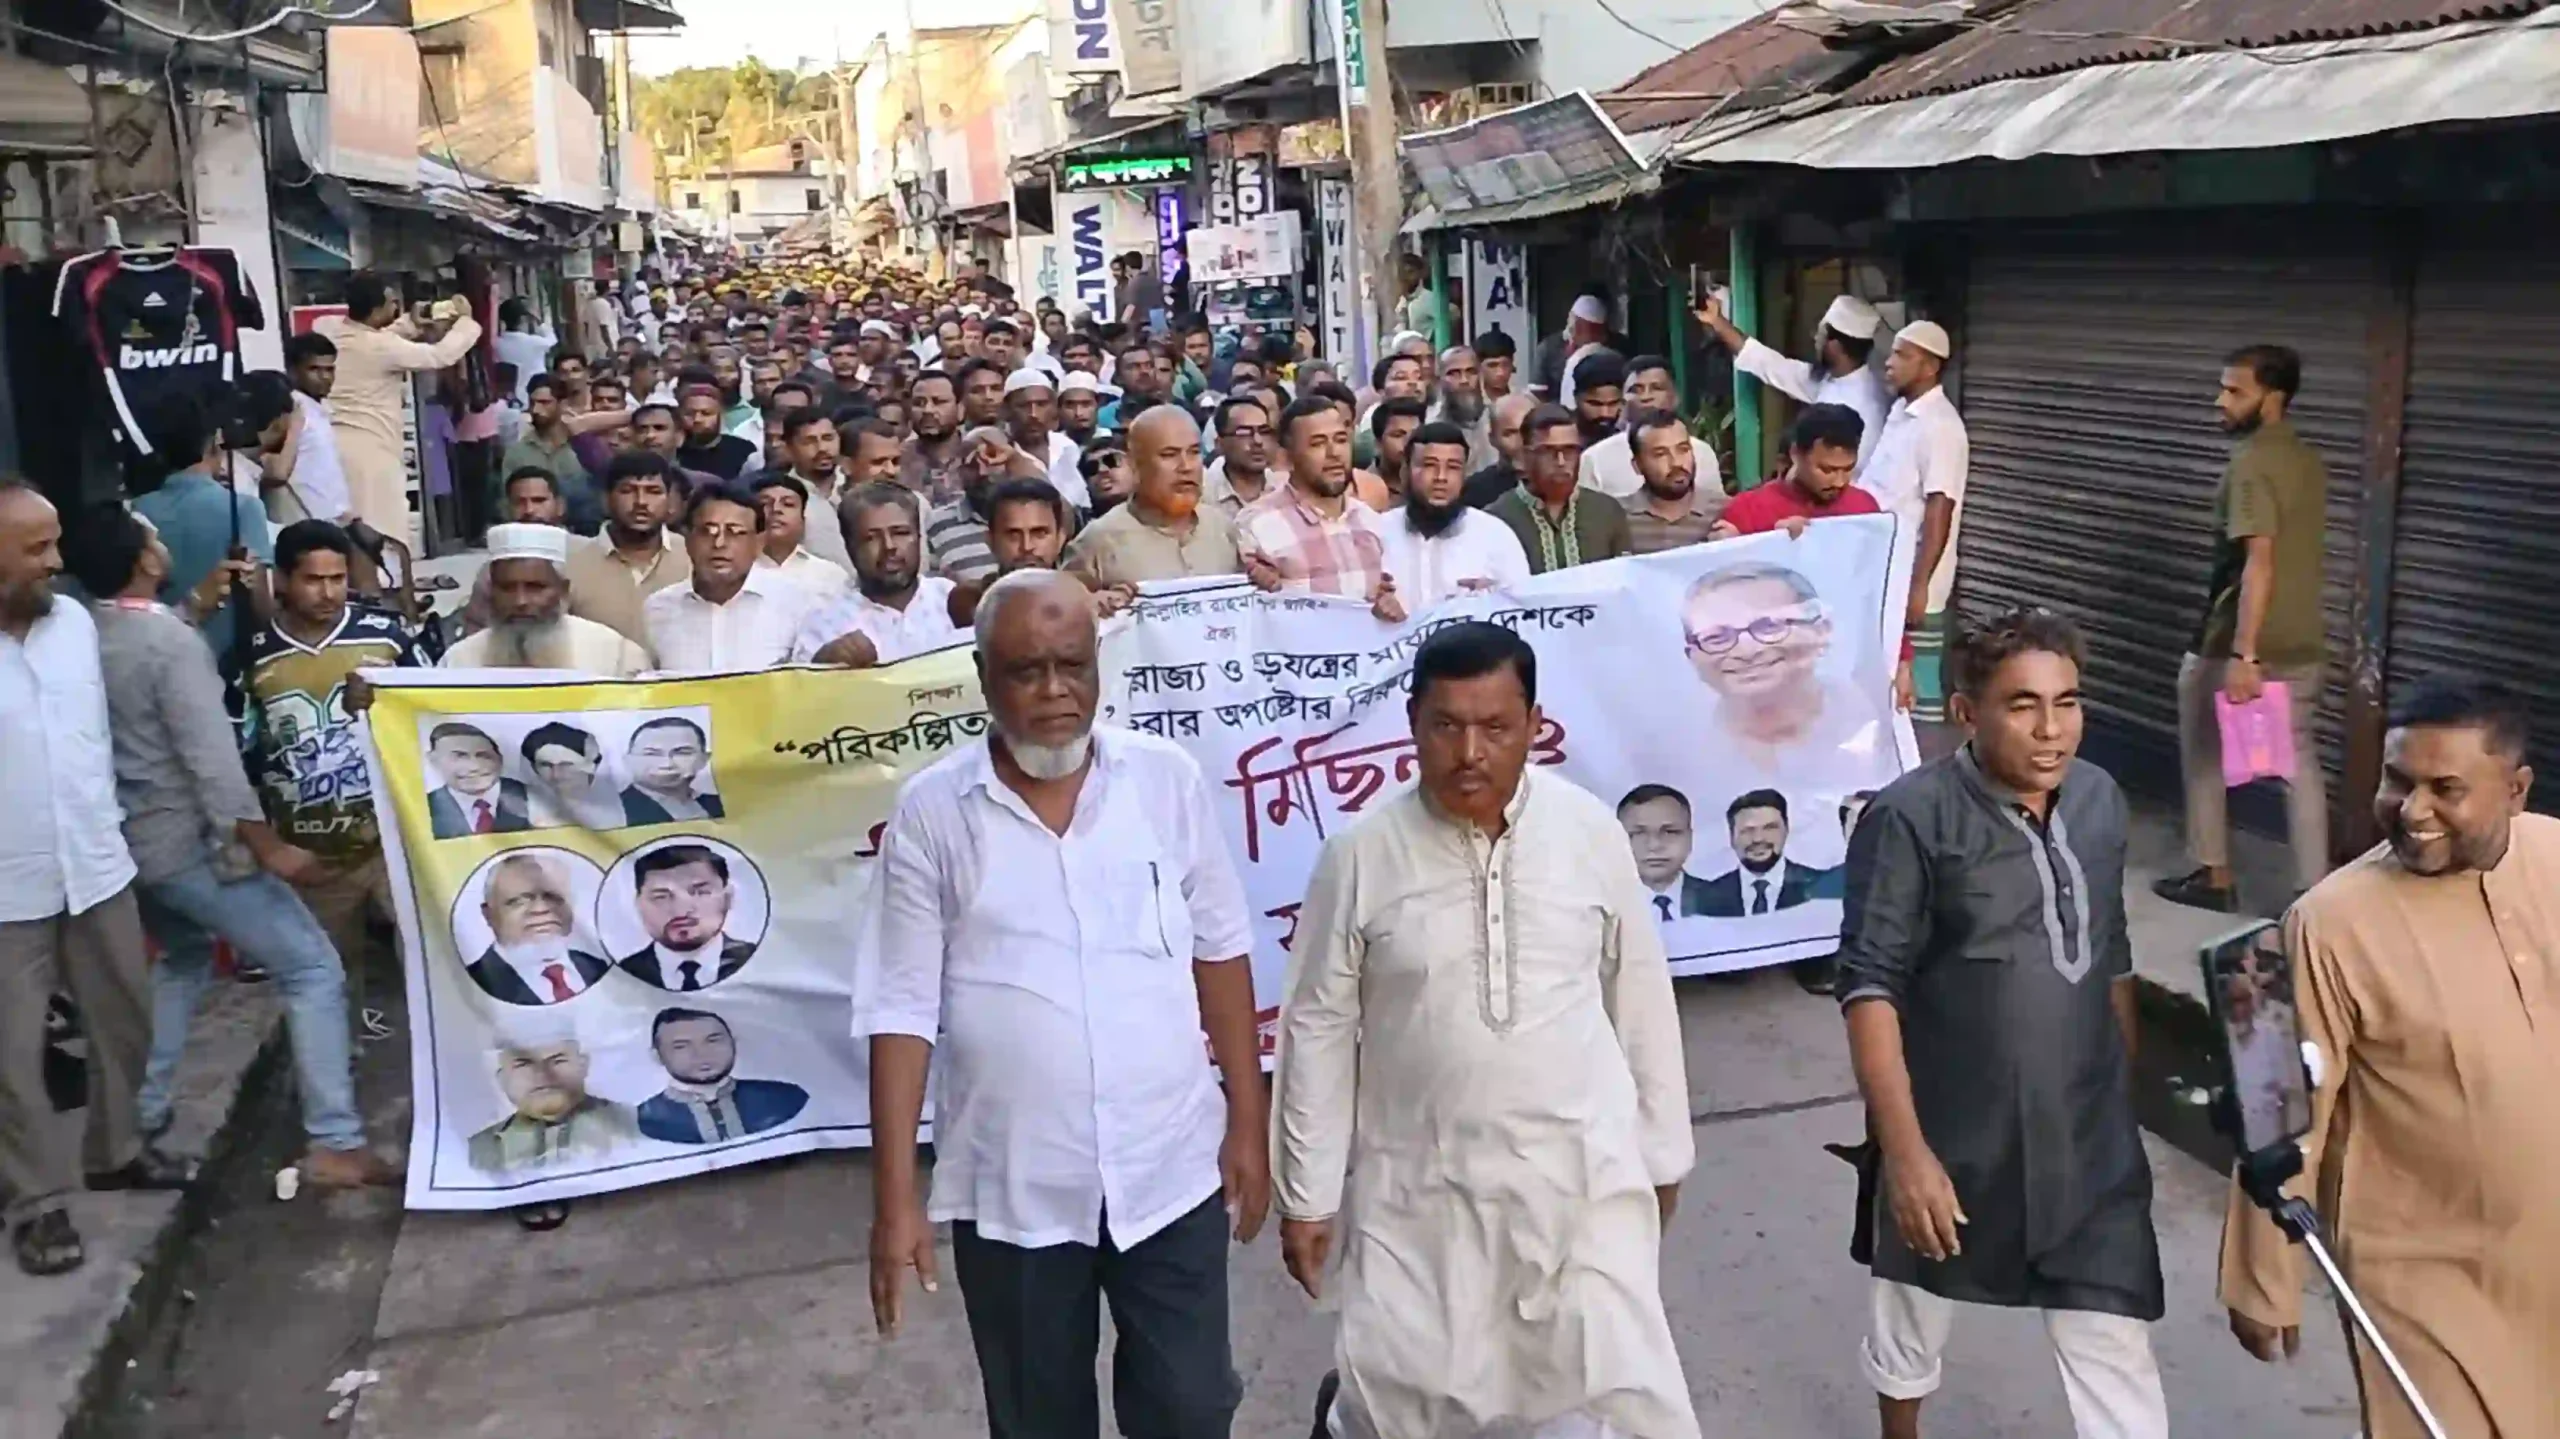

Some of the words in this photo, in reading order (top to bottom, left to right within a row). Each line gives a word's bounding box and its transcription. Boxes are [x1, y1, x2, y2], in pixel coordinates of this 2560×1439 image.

[1073, 204, 1107, 320] WALT
[119, 342, 218, 370] bwin
[1218, 660, 1243, 682] ও
